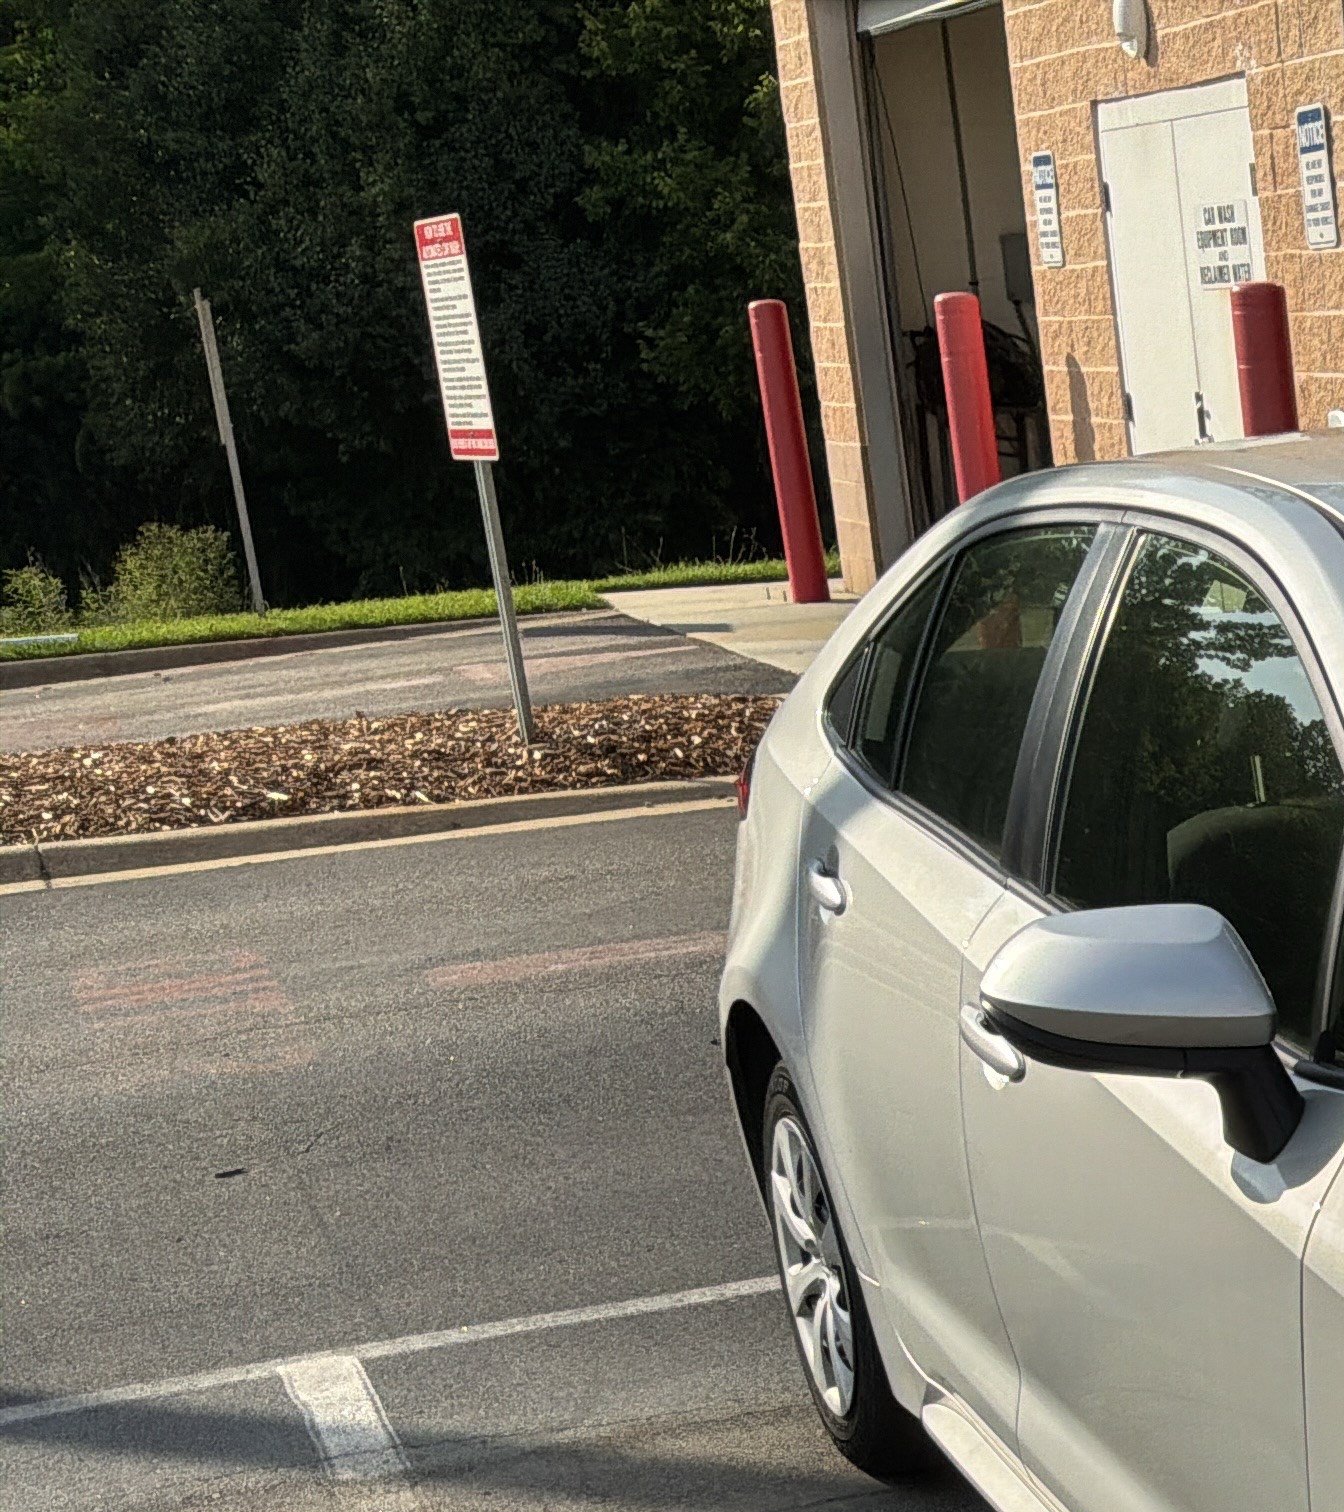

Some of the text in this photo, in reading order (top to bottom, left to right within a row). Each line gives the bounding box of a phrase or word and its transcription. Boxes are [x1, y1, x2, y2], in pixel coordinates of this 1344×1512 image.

[1298, 121, 1324, 147] NOTICE
[1203, 204, 1236, 226] CAR WASH
